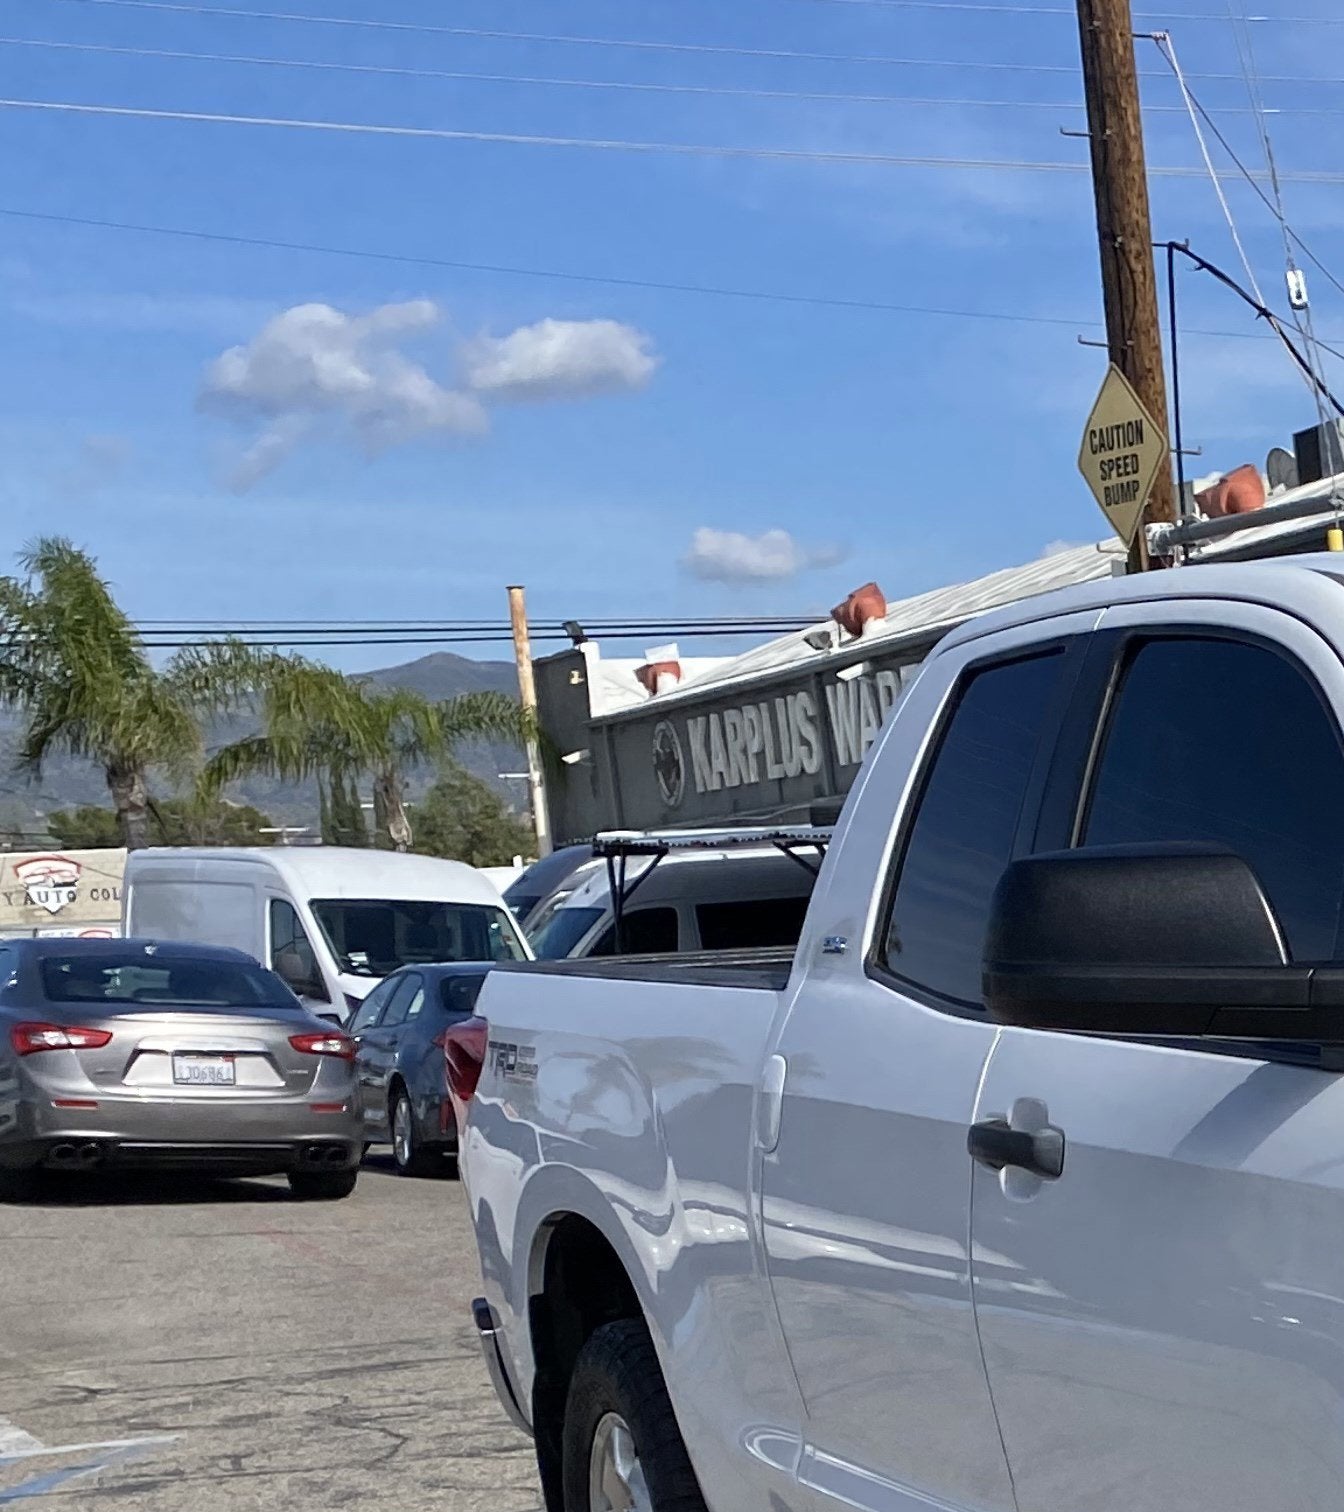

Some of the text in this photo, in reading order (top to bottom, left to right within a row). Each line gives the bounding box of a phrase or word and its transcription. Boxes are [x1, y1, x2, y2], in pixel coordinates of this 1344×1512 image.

[1089, 418, 1144, 455] CAUTION
[1099, 453, 1139, 481] SPEED
[1104, 480, 1139, 507] BUMP
[687, 691, 821, 793] KARPLUS
